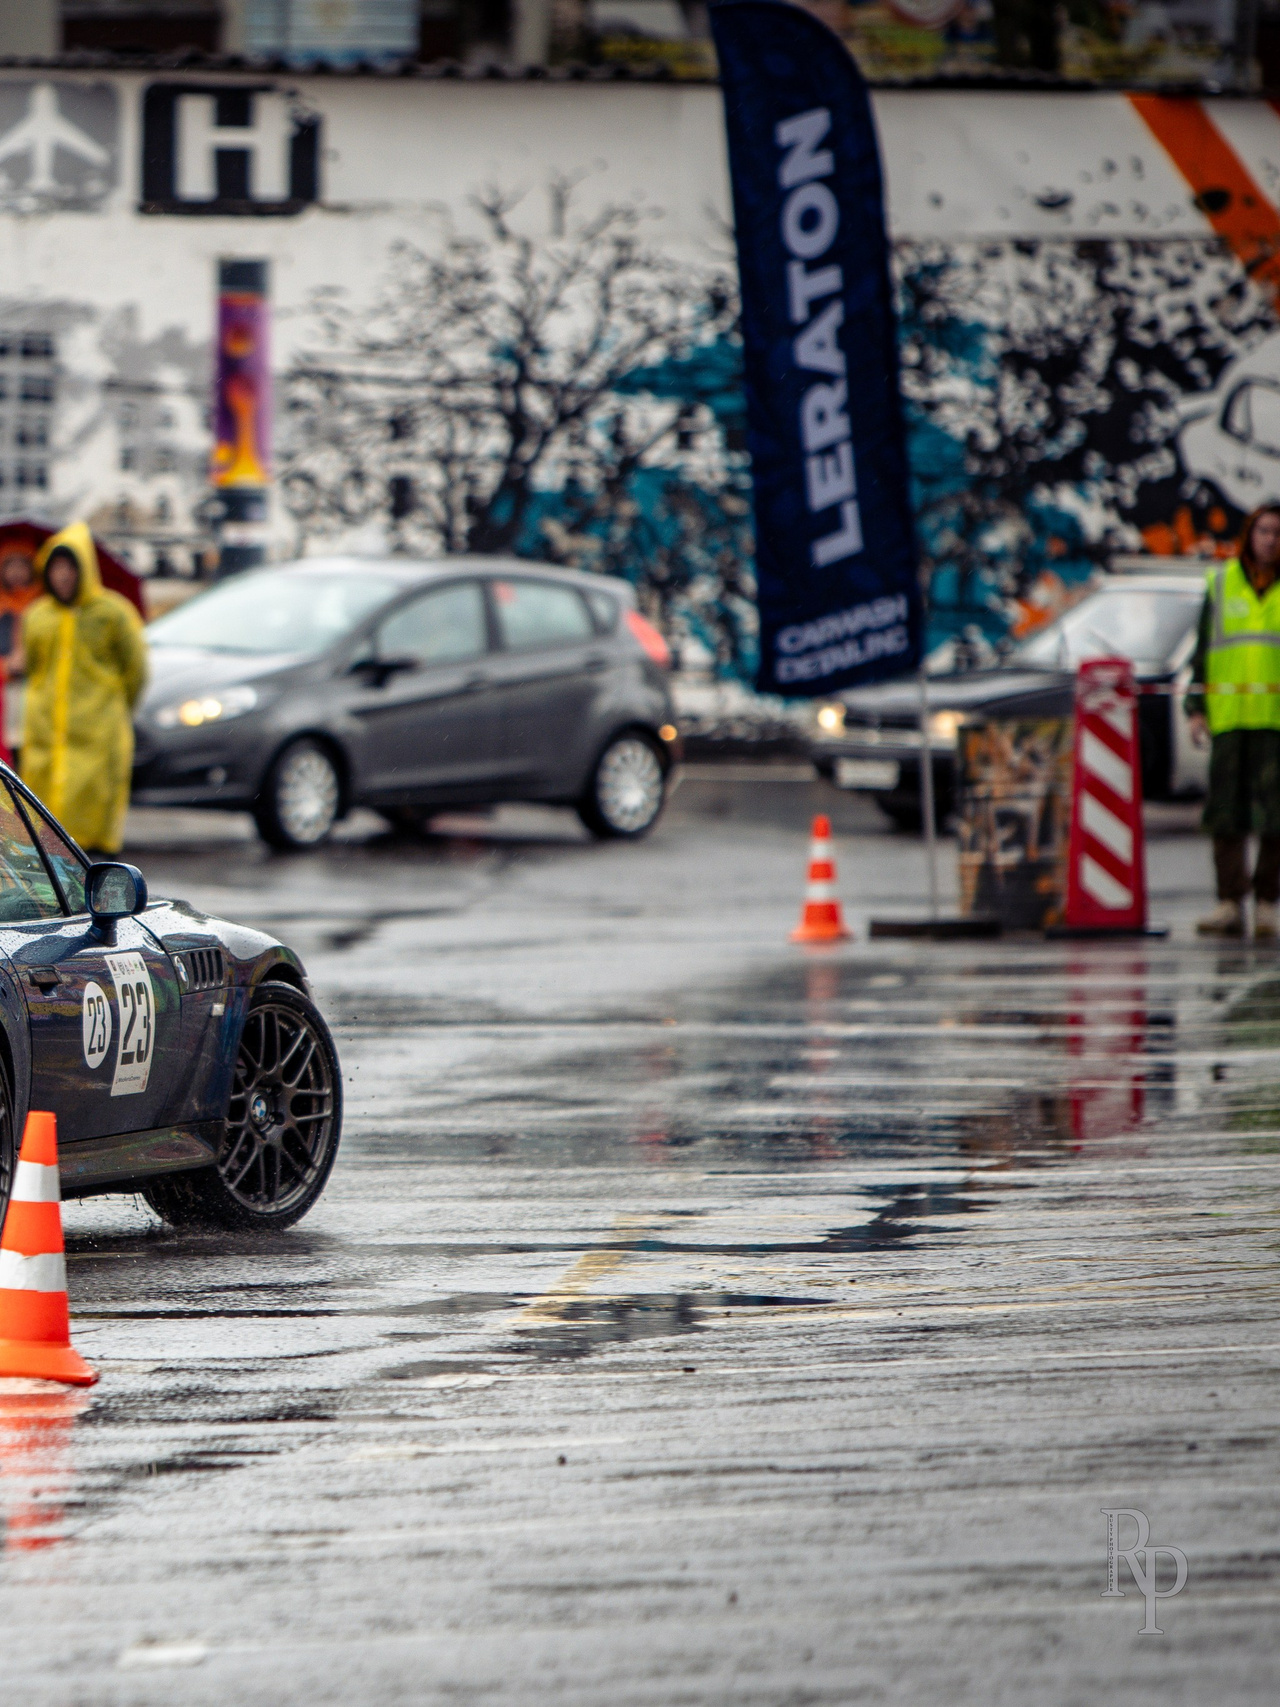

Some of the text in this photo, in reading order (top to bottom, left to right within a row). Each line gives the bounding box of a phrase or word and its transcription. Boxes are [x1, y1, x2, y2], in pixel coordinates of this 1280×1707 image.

[174, 93, 292, 201] H
[773, 107, 864, 568] LERATON
[87, 995, 106, 1055] 23
[120, 982, 151, 1066] 23
